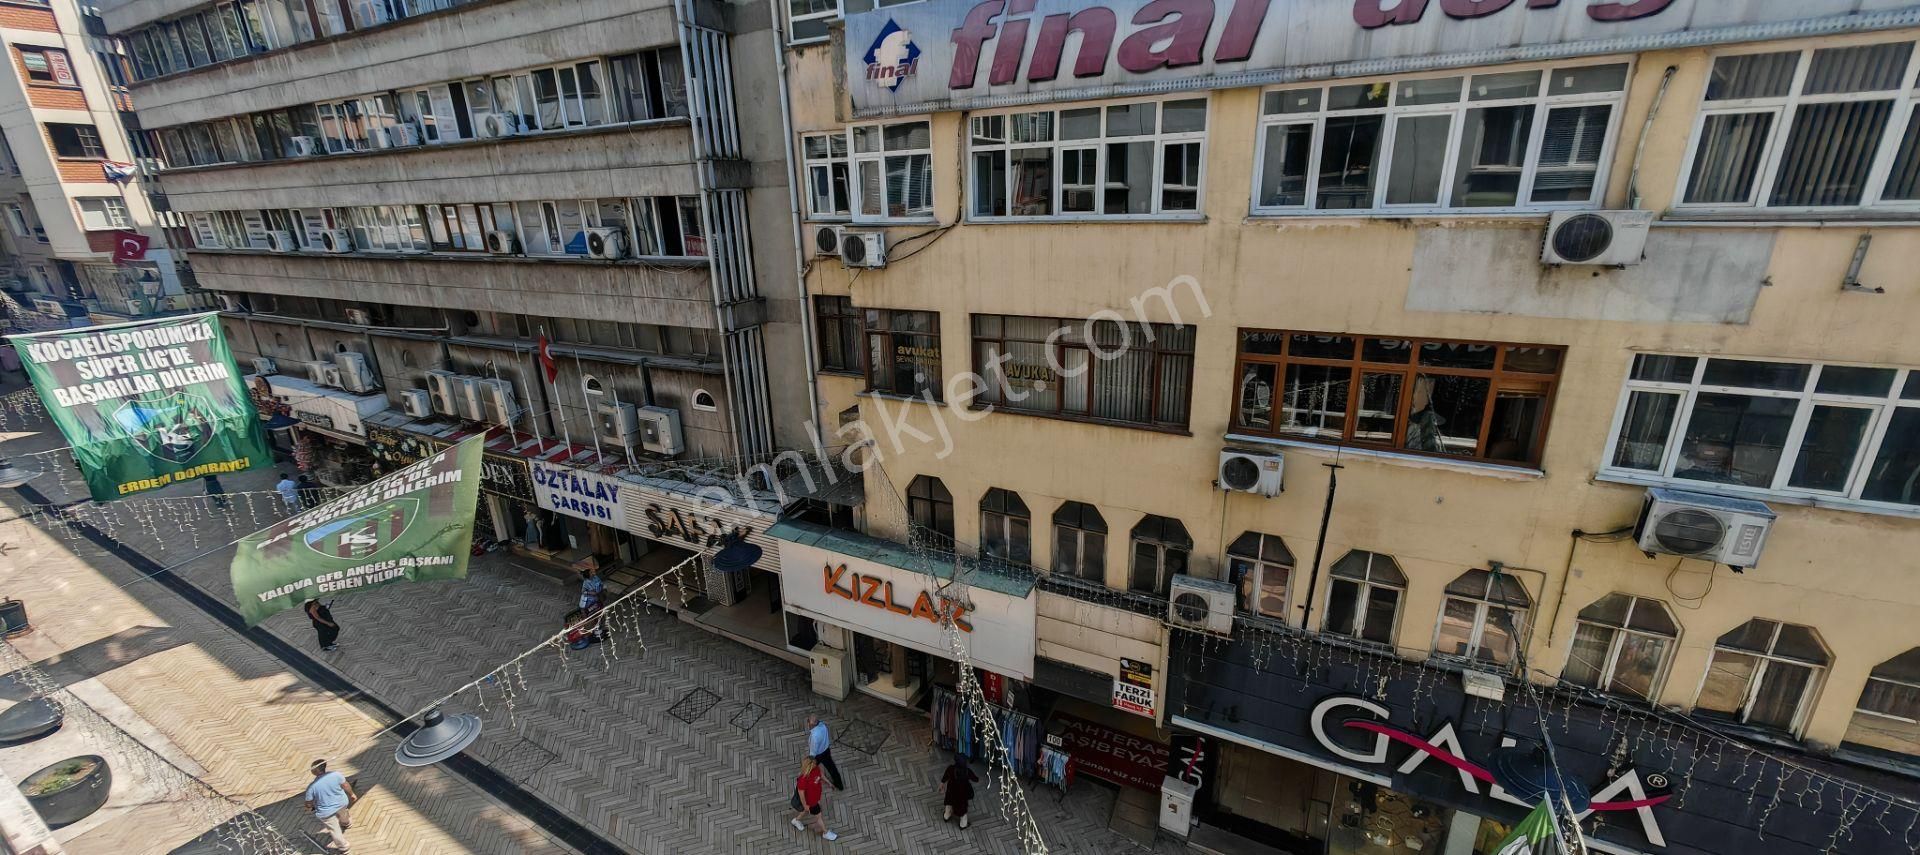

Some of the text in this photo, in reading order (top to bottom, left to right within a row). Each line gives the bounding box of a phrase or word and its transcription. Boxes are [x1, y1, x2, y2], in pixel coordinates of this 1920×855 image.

[866, 58, 919, 81] final
[27, 322, 216, 364] KOCAELİSPORUMUZA
[897, 345, 940, 358] avukat
[75, 354, 140, 381] SÜPER
[1007, 363, 1056, 382] AVUKAT
[52, 361, 229, 408] BAŞARILAR DİLERİM
[118, 457, 250, 495] ERDEM DOMBAYCI
[384, 469, 461, 500] DİLERİM
[533, 462, 620, 504] ÖZTALAY
[550, 493, 612, 521] ÇARŞISI
[257, 555, 454, 602] YALOVA GFB ANGELS BAŞKANI
[318, 566, 406, 593] CEREN YILDIZ
[1115, 691, 1152, 707] FARUK
[1118, 683, 1151, 699] TERZİ
